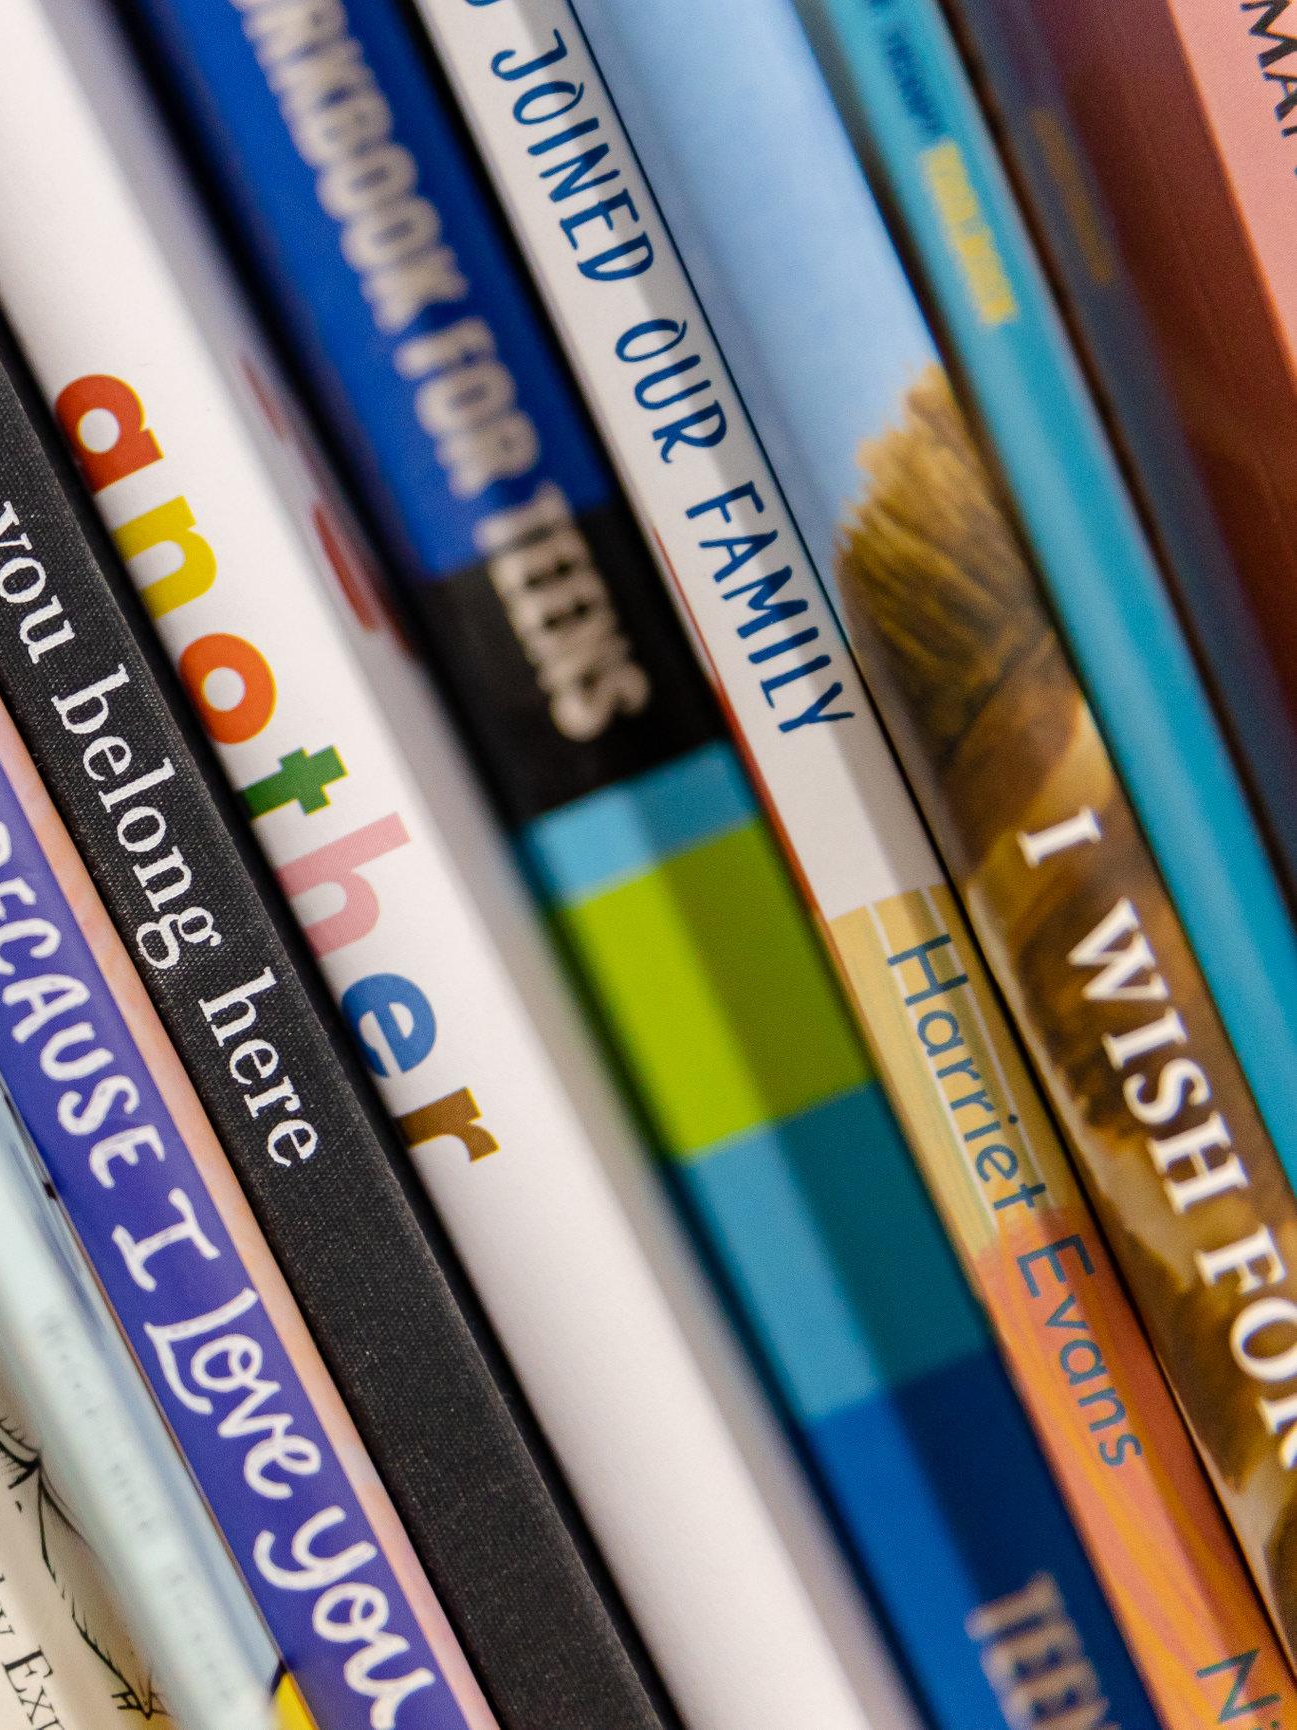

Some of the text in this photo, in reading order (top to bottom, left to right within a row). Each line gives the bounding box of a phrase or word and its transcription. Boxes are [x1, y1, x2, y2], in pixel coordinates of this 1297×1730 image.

[230, 0, 650, 743] RKBOOK FOR TEENS
[490, 28, 856, 733] JOINED OUR FAMILY
[51, 662, 222, 971] belong
[198, 966, 320, 1168] here
[55, 373, 501, 1164] another
[1017, 807, 1103, 868] I
[1066, 896, 1250, 1215] WISH
[112, 1187, 220, 1292] I
[886, 933, 1143, 1468] Harriet Evans
[0, 1644, 65, 1730] Ex
